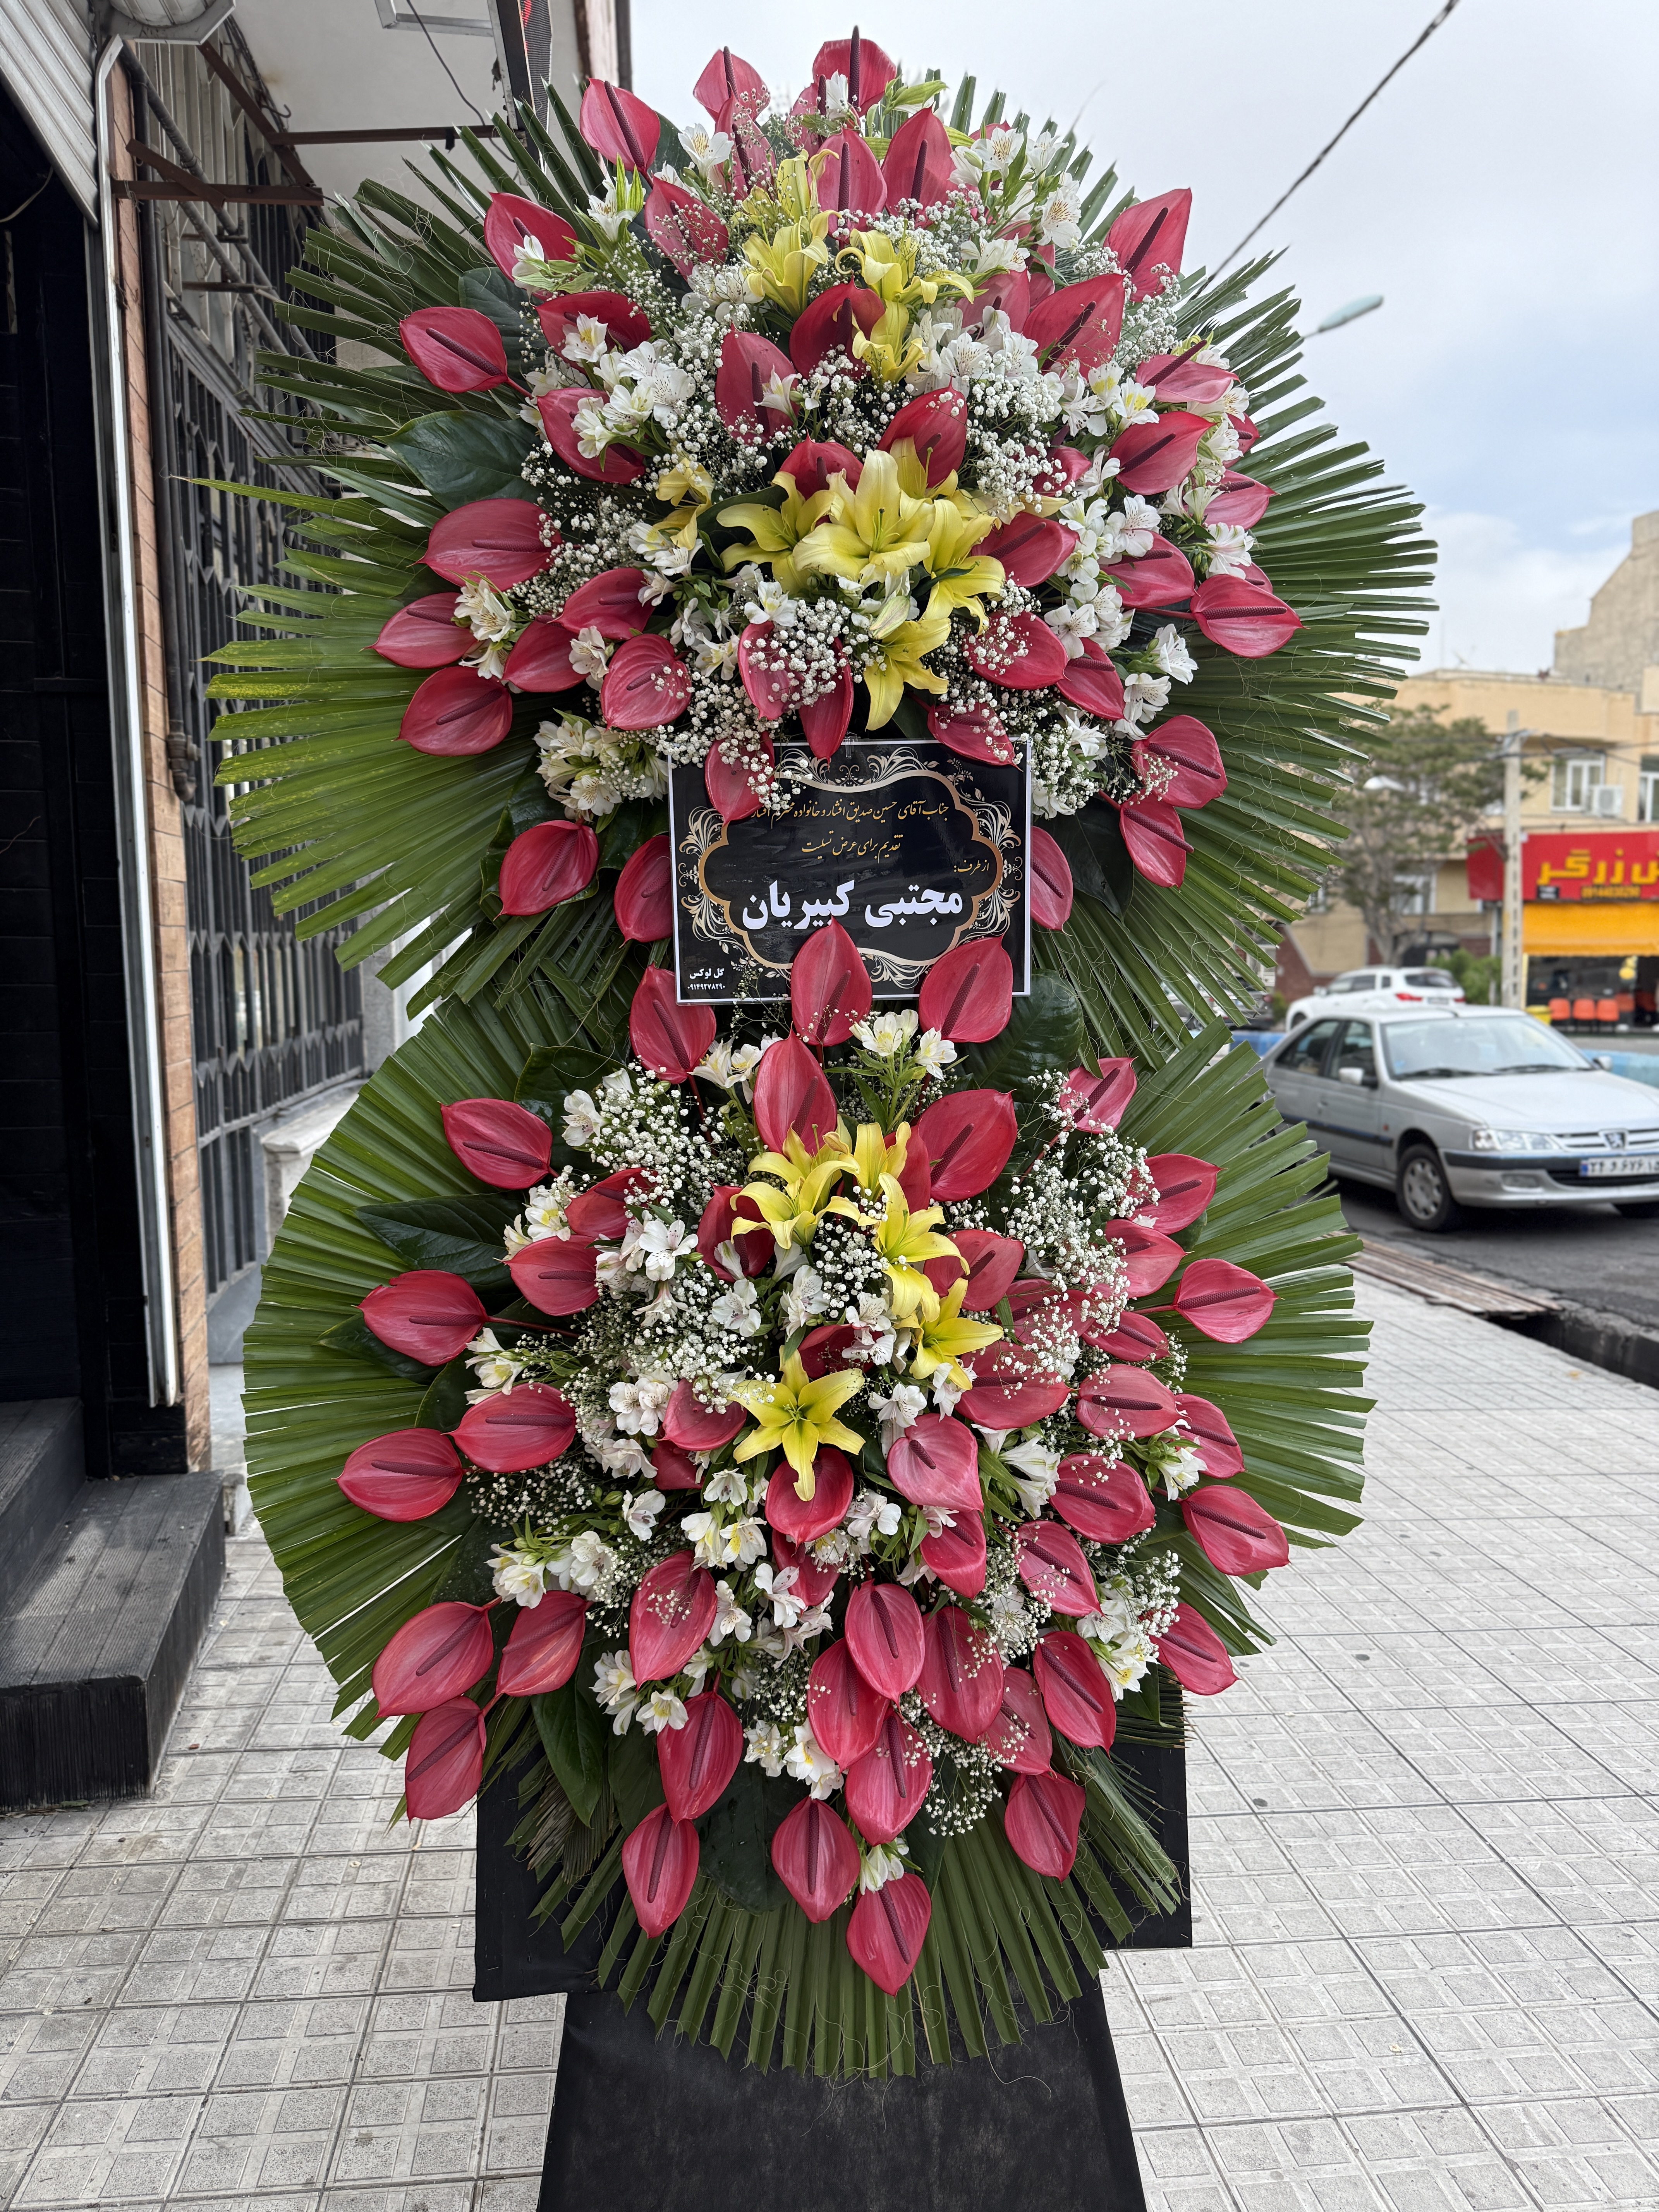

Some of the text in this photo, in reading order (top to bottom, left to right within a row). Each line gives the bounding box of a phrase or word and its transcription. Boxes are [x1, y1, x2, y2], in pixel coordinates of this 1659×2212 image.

[794, 800, 820, 817] خانواده
[826, 799, 845, 817] افشار
[846, 802, 872, 823] صدیق
[873, 801, 897, 823] حسین
[898, 800, 926, 819] آقای
[922, 802, 949, 821] جناب
[802, 830, 903, 864] تقدیم برای عرض تسلیت
[981, 859, 989, 872] از
[742, 880, 963, 930] مجتبی کبیریان
[689, 968, 725, 979] گل لوکس
